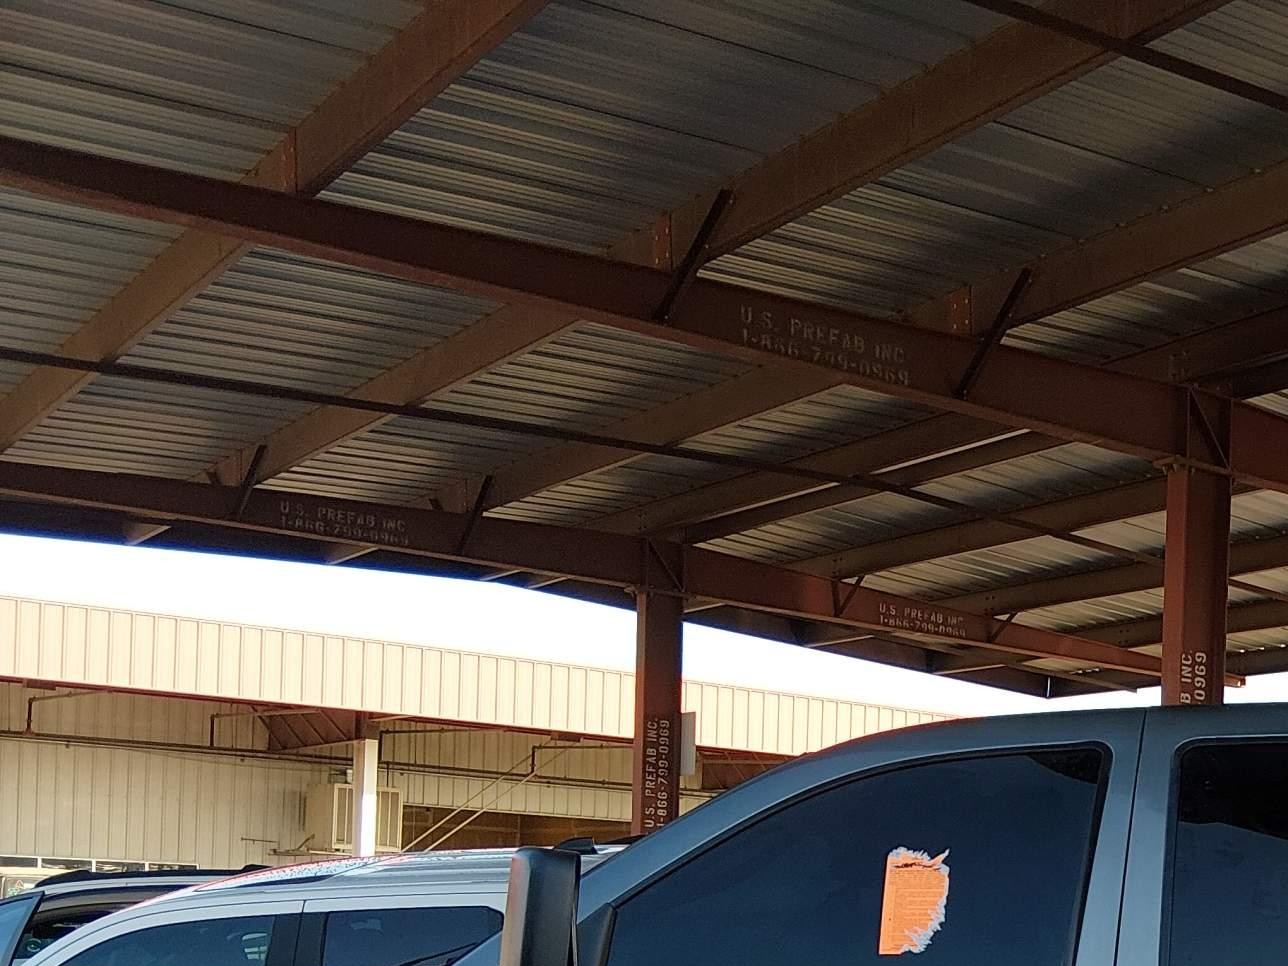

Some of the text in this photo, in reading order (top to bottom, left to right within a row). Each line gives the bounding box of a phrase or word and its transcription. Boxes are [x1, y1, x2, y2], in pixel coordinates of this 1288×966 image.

[788, 317, 865, 353] PREFAB
[317, 507, 376, 528] PREFAB
[904, 607, 944, 624] PREFAB
[645, 748, 657, 797] PREFAB
[656, 718, 670, 827] 1-866-799-0969
[644, 803, 656, 829] U.S.
